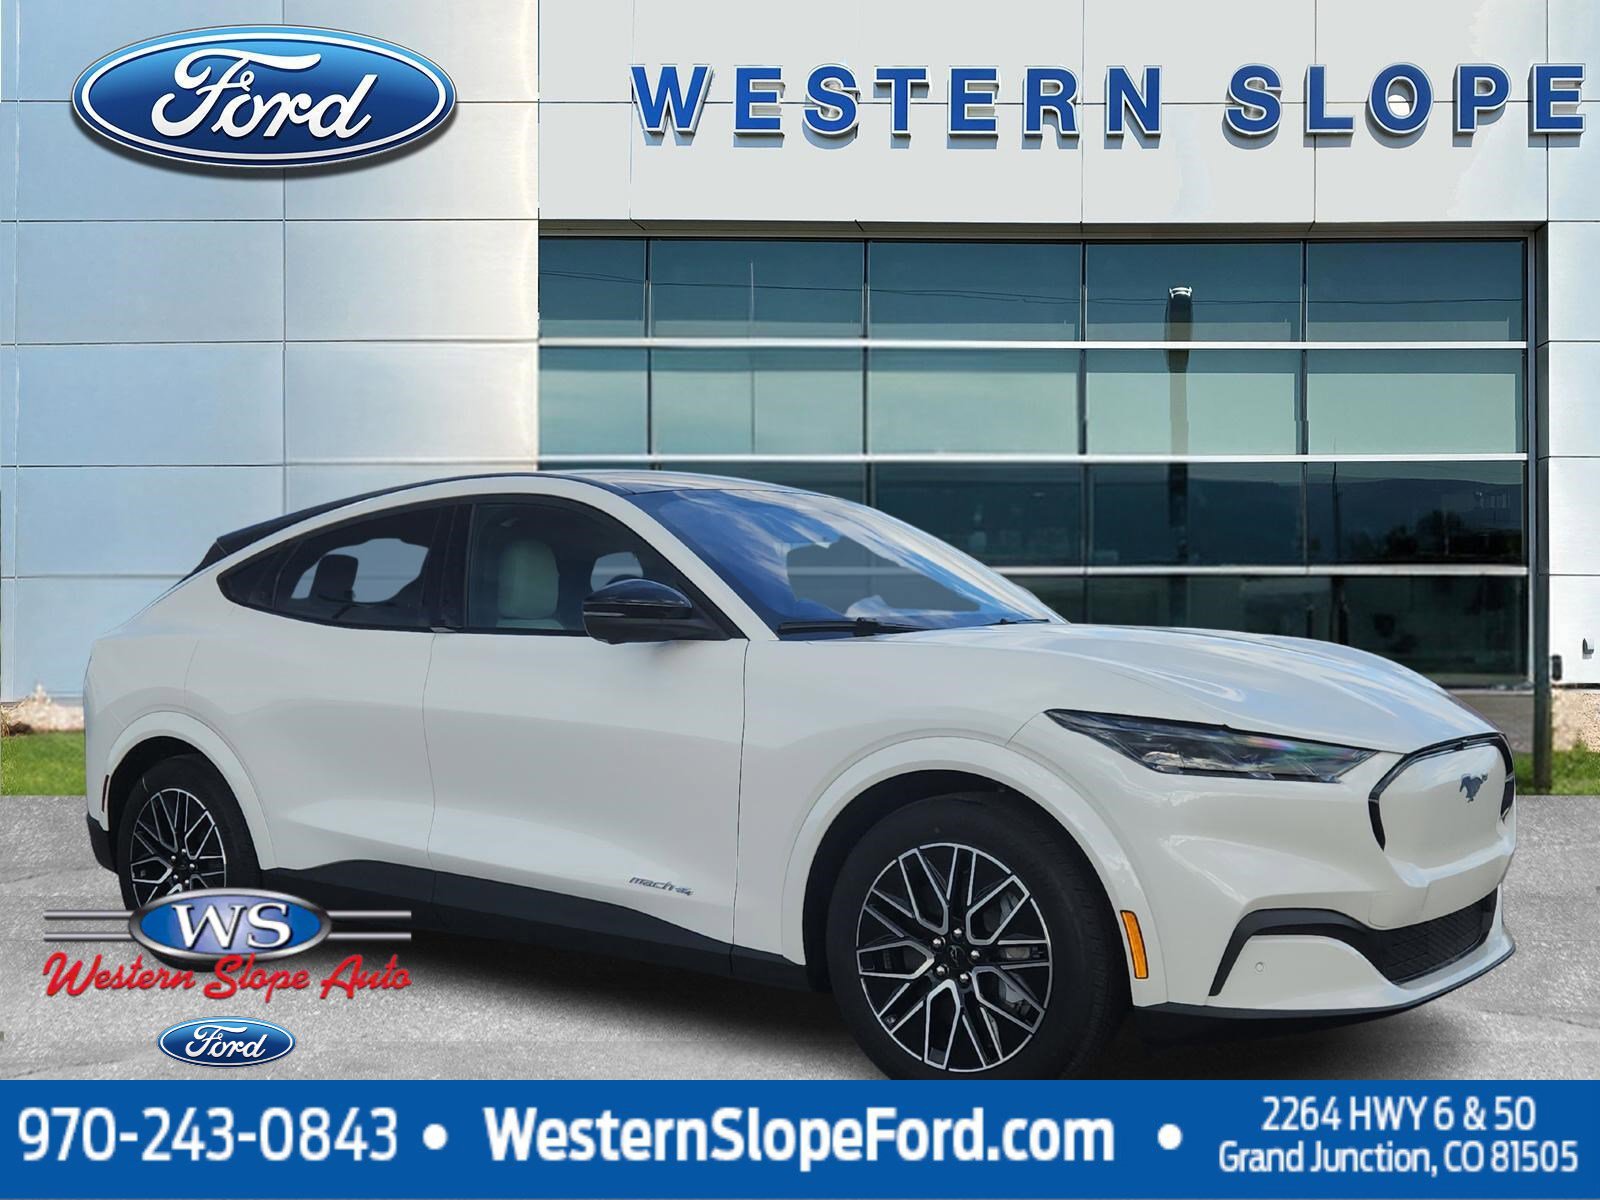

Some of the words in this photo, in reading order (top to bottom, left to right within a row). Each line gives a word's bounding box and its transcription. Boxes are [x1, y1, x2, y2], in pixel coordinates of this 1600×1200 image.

[150, 48, 378, 139] Ford
[629, 64, 1163, 139] WESTERN
[1224, 62, 1587, 136] SLOPE
